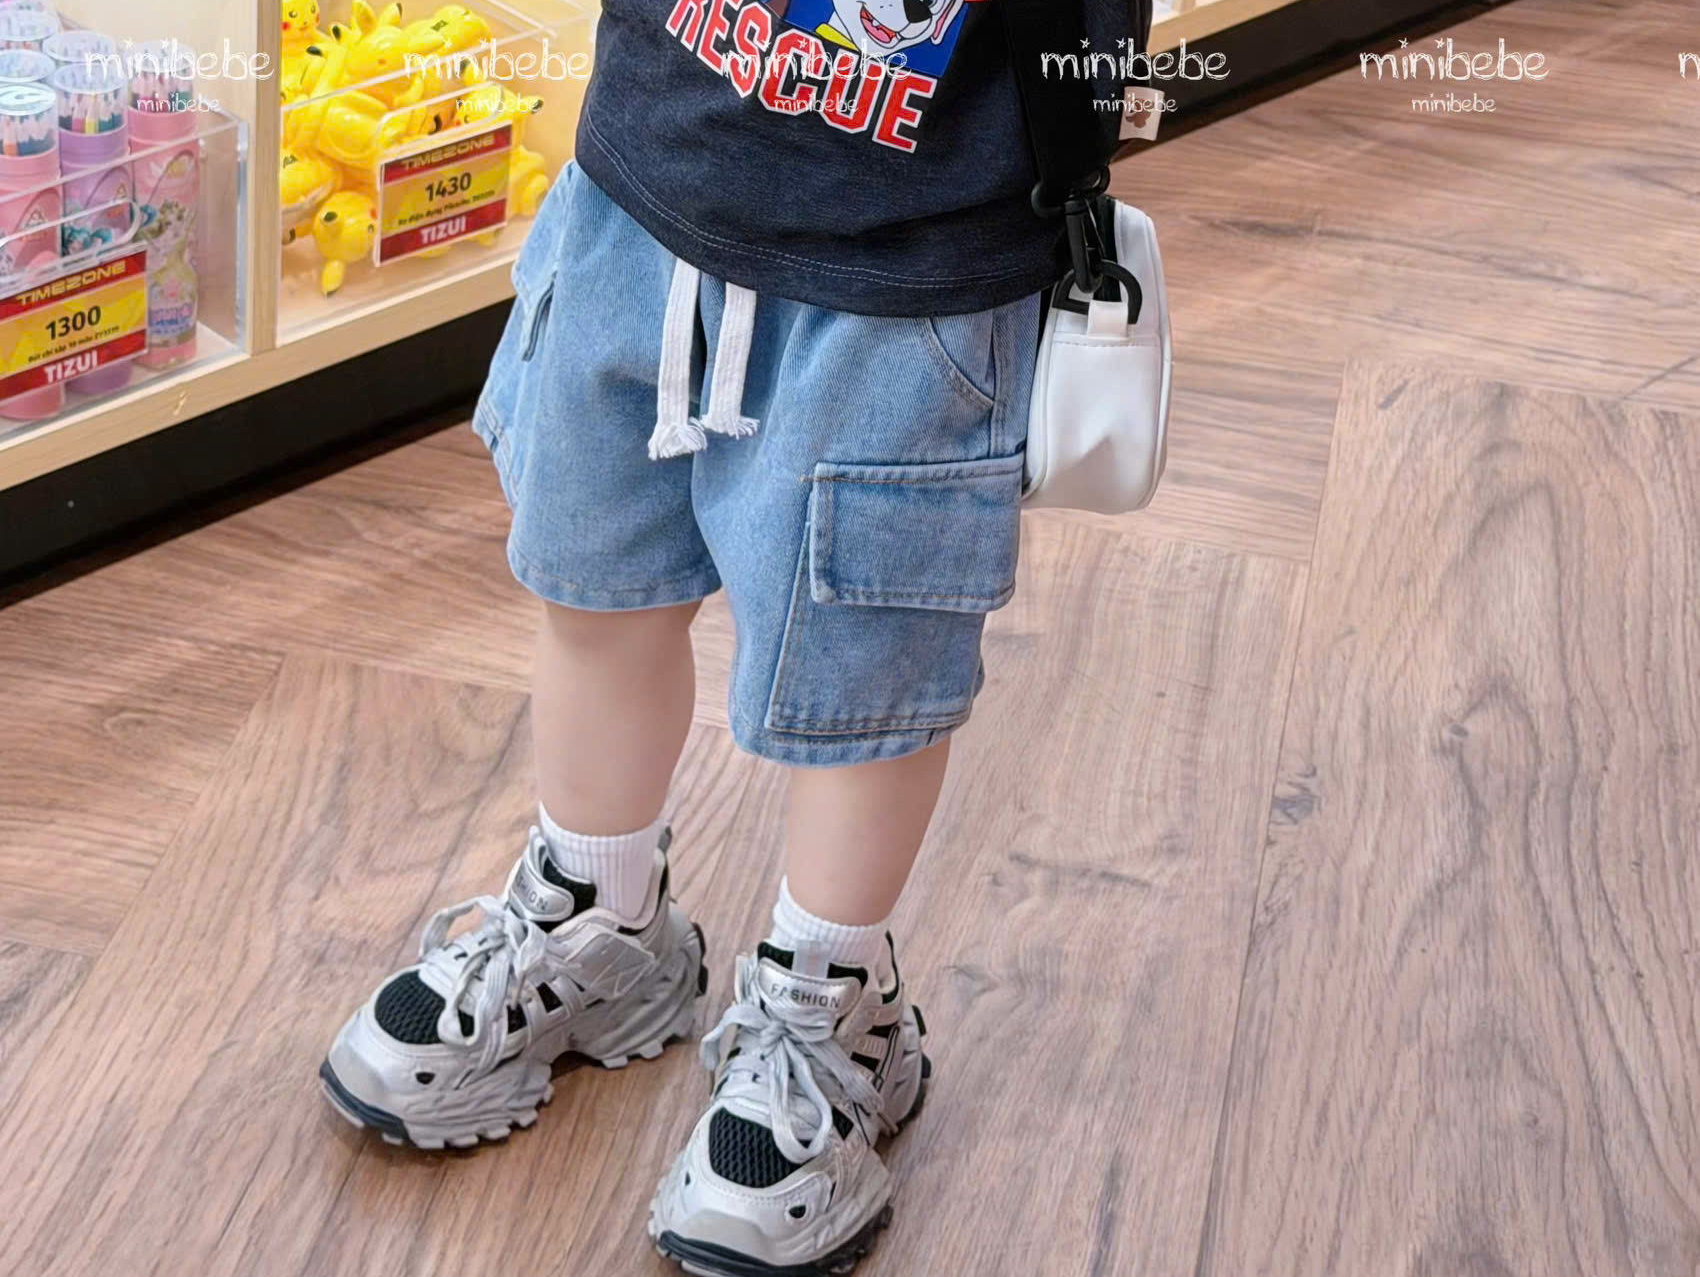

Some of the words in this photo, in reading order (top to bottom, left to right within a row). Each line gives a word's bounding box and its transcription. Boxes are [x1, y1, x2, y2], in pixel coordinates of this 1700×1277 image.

[404, 134, 494, 171] TIMEZONE
[425, 172, 472, 202] 1430
[421, 216, 467, 244] TIZUI
[16, 259, 127, 306] TIMEZONE
[45, 305, 102, 341] 1300
[45, 350, 98, 383] TIZUI
[770, 982, 842, 1009] FASHION
